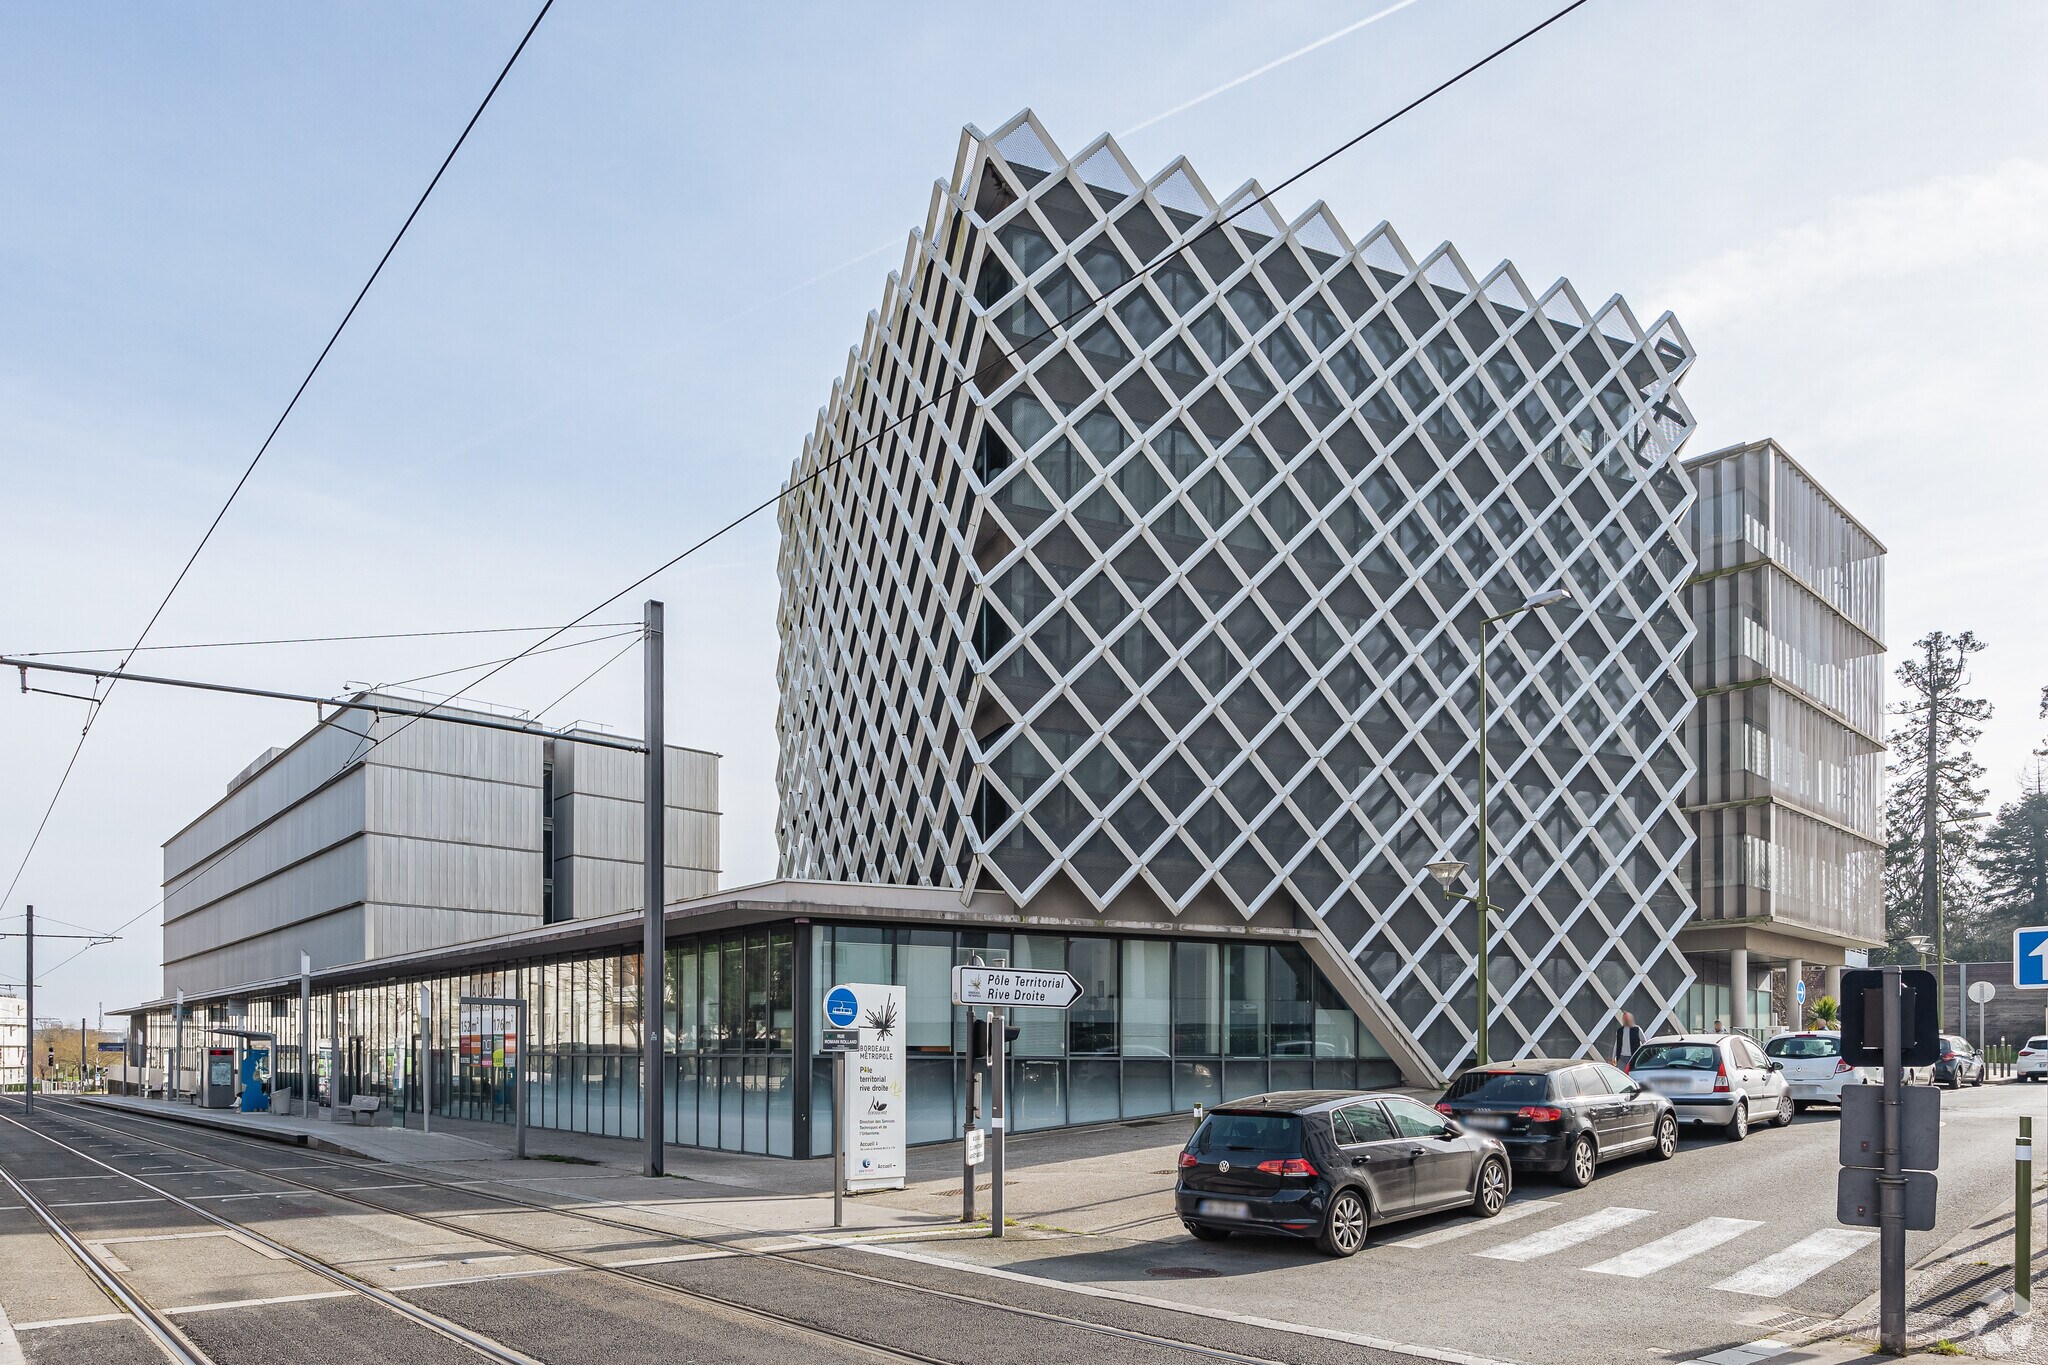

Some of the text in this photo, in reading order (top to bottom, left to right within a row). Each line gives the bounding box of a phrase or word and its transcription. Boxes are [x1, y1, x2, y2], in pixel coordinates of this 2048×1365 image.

[988, 974, 1065, 989] Pôle Territorial
[988, 988, 1046, 1001] Rive Droite
[859, 1052, 893, 1060] MÉTROPOLE
